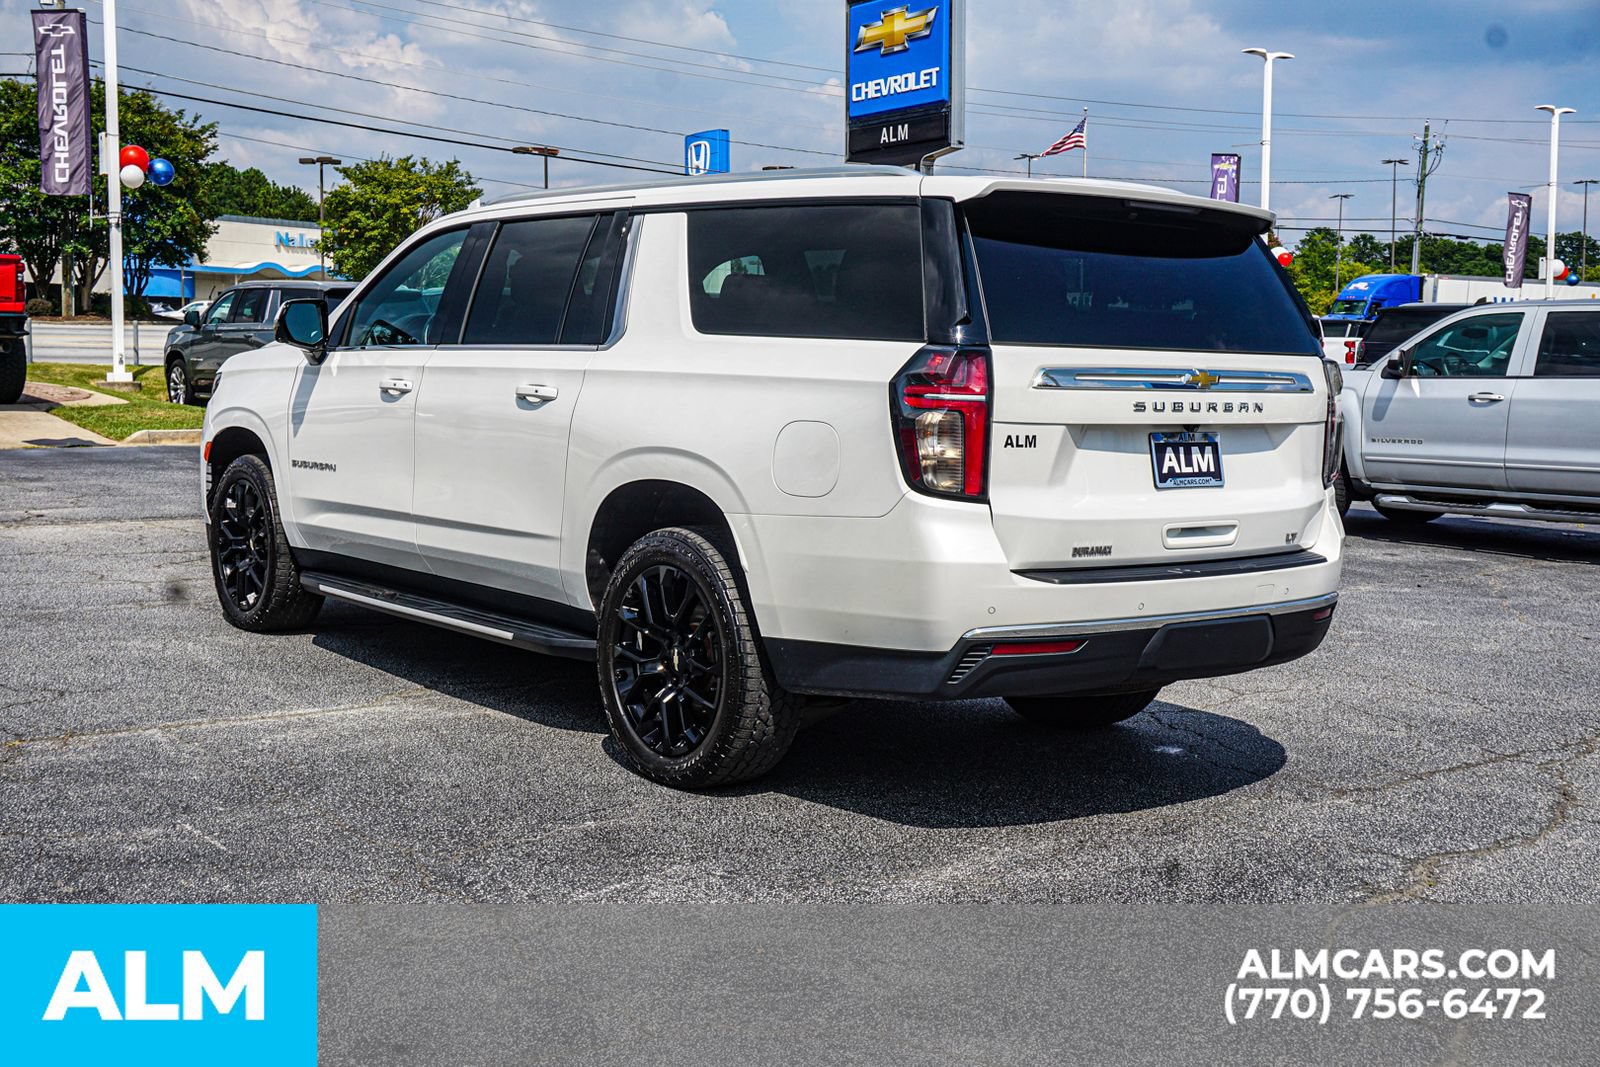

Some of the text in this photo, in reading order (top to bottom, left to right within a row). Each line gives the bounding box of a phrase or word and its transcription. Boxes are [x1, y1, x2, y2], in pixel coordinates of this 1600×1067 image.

[851, 66, 940, 102] CHEVROLET
[880, 123, 909, 144] ALM
[1133, 401, 1264, 413] SUBURBAN
[1003, 435, 1037, 449] ALM
[1178, 433, 1196, 442] ALM
[291, 459, 337, 472] SUBURBAN
[1162, 446, 1215, 474] ALM
[1286, 532, 1298, 544] LT
[1071, 545, 1113, 557] DURAMAX
